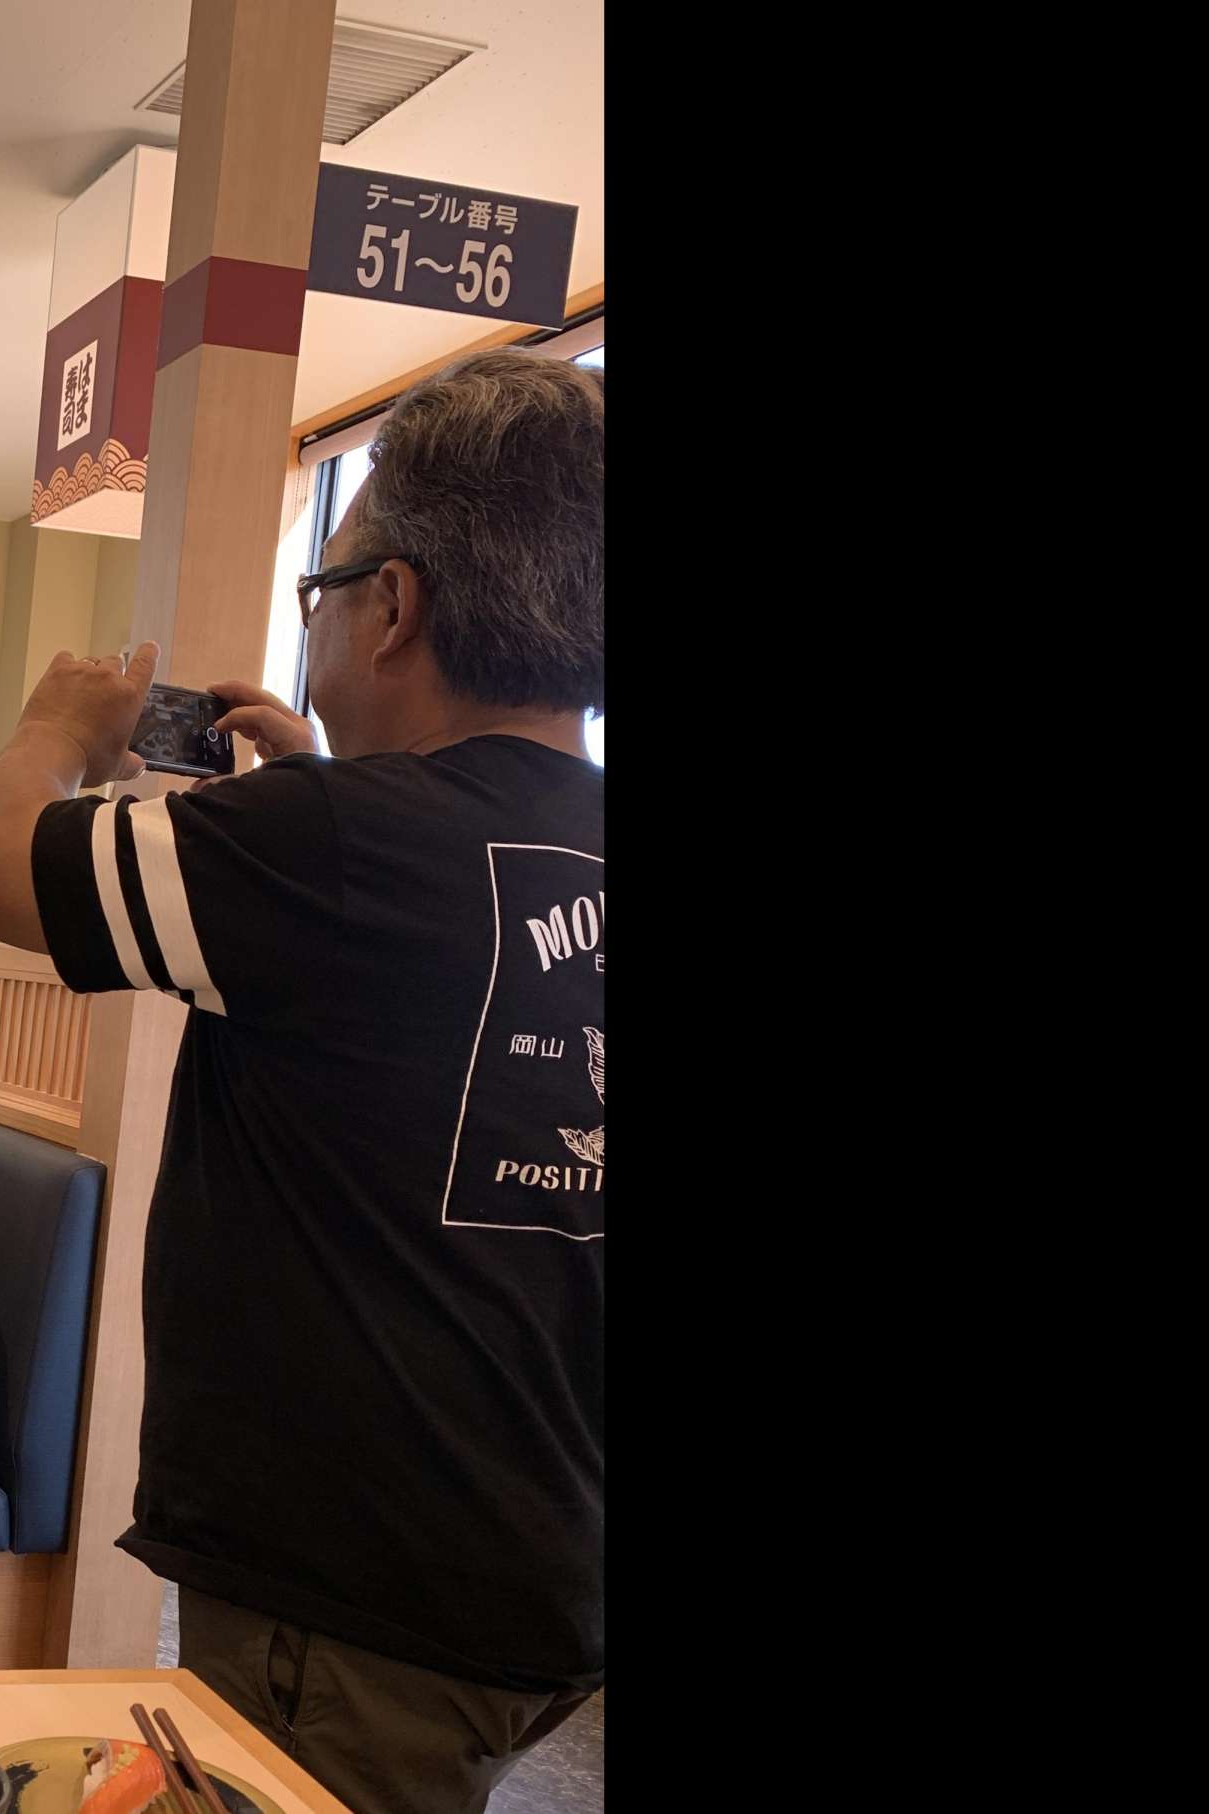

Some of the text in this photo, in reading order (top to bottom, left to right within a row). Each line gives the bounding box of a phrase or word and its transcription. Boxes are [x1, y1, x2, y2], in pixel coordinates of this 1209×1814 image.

[366, 183, 519, 235] テーブル番号
[526, 891, 605, 973] MO
[509, 1033, 565, 1060] 岡山
[495, 1159, 603, 1192] POSITI
